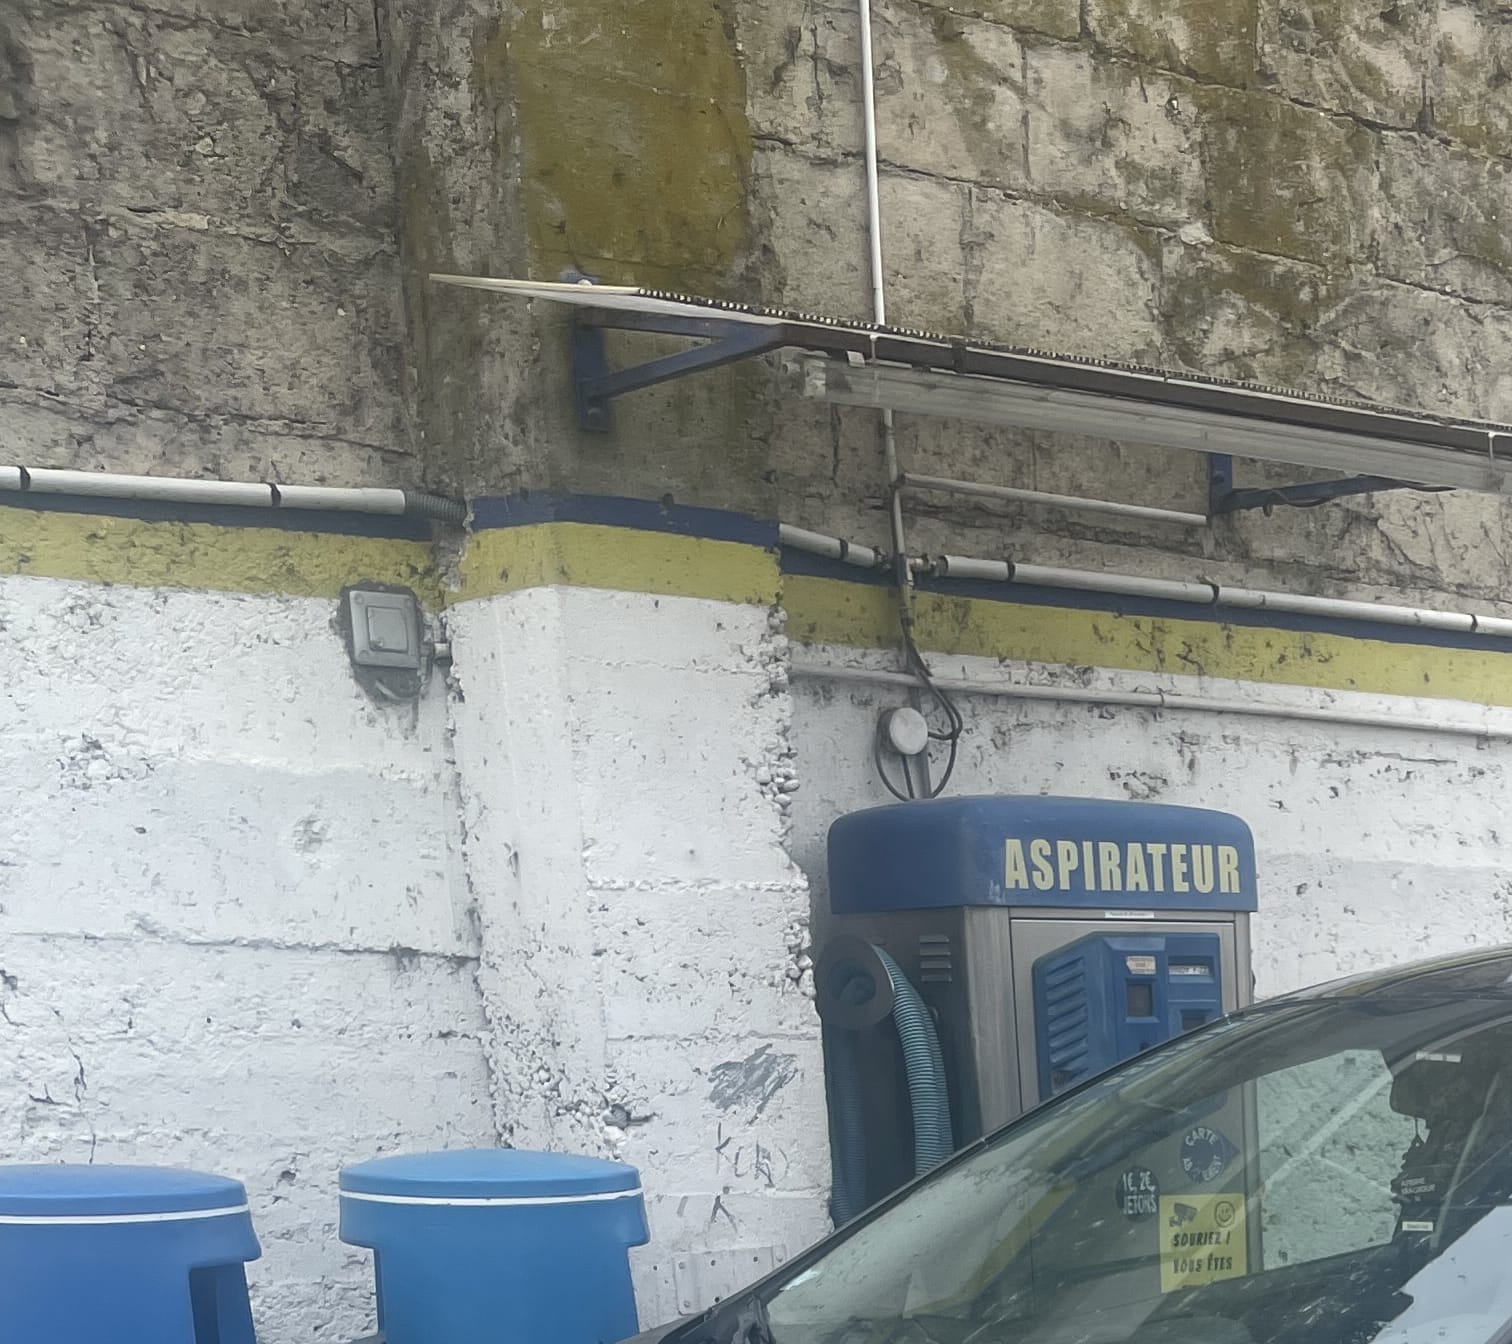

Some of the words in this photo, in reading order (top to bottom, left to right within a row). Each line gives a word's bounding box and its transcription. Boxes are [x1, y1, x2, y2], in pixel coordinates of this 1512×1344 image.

[1005, 838, 1241, 894] ASPIRATEUR
[1185, 1127, 1218, 1146] CARTE
[1173, 1231, 1221, 1247] SOURIEZ
[1173, 1258, 1202, 1274] VOUS
[1207, 1253, 1233, 1271] ÊTES
